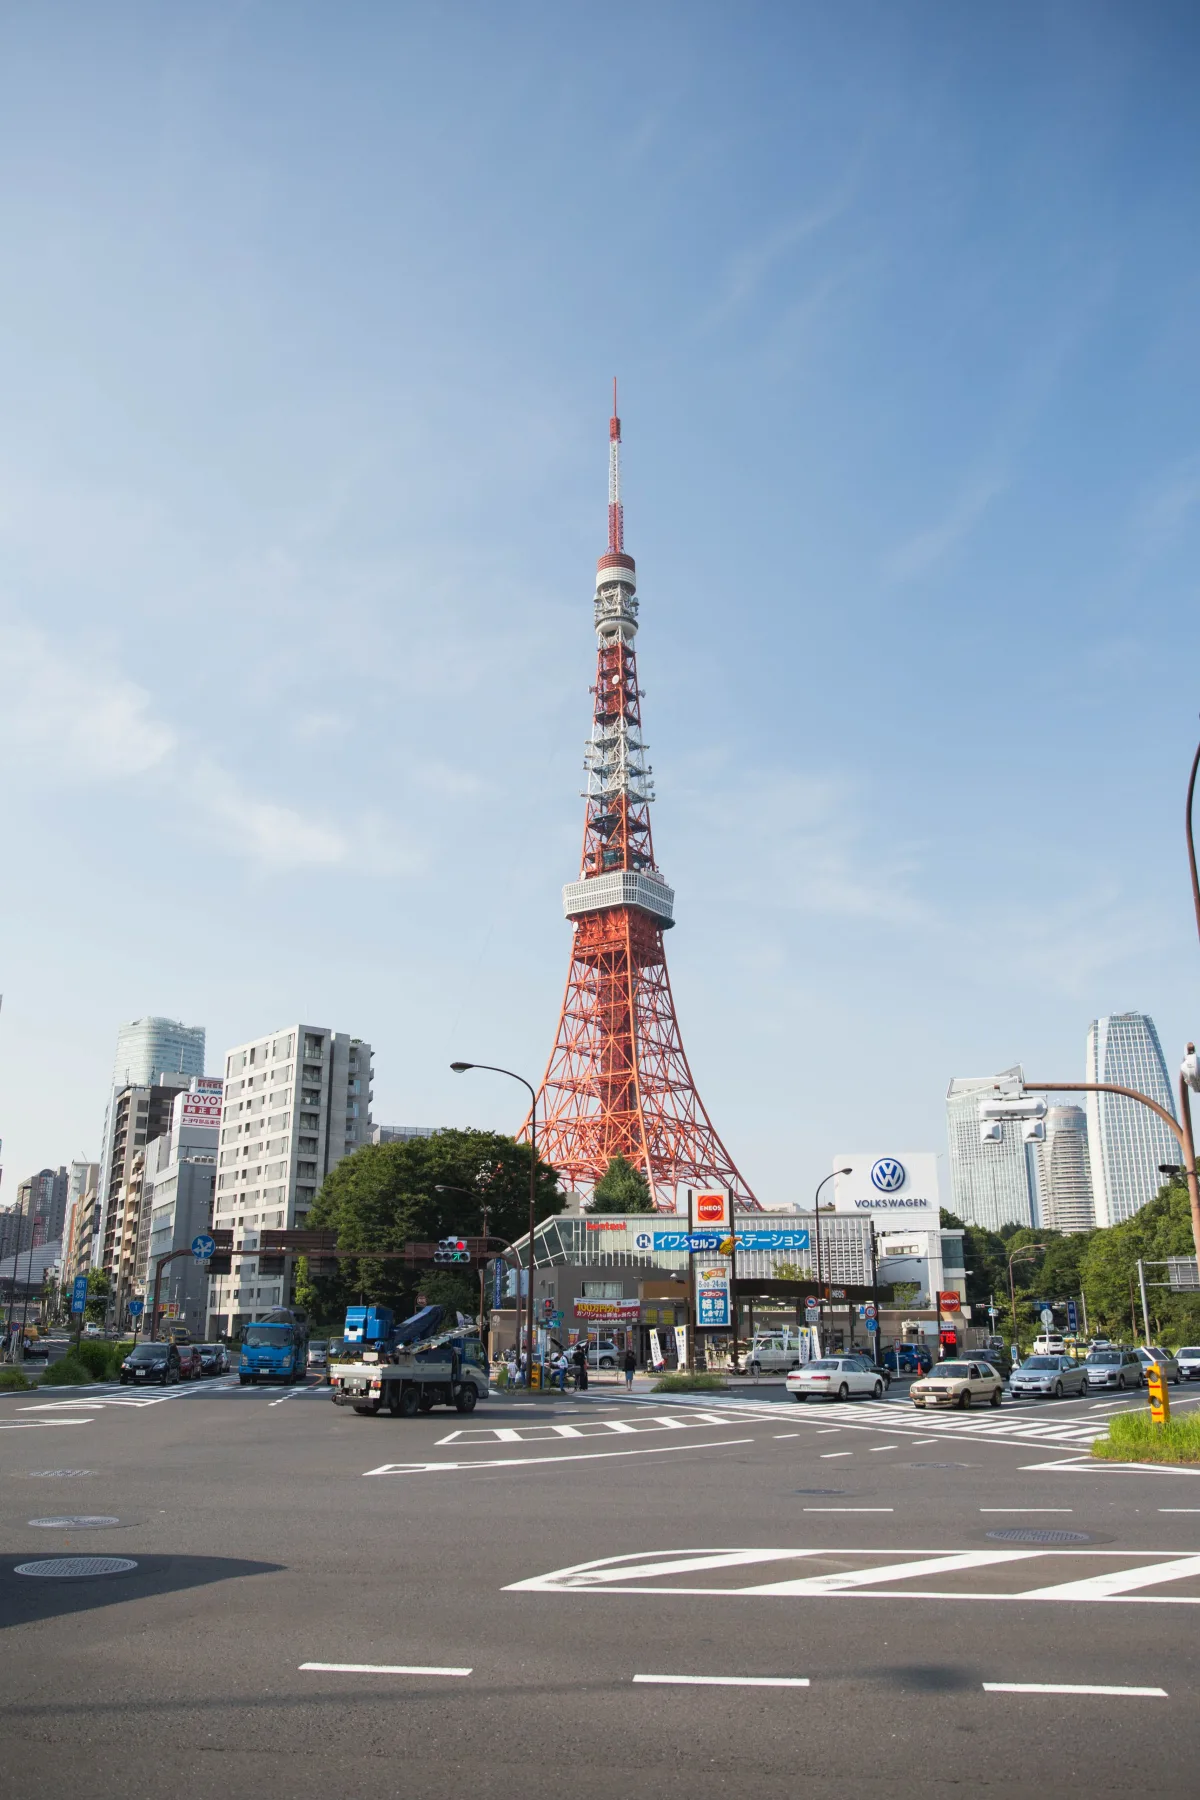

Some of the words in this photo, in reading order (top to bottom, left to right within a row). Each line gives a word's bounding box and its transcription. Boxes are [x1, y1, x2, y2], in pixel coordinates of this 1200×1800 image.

[854, 1199, 927, 1208] VOLKSWAGEN
[690, 1238, 717, 1249] セルフ
[701, 1299, 725, 1310] 給油
